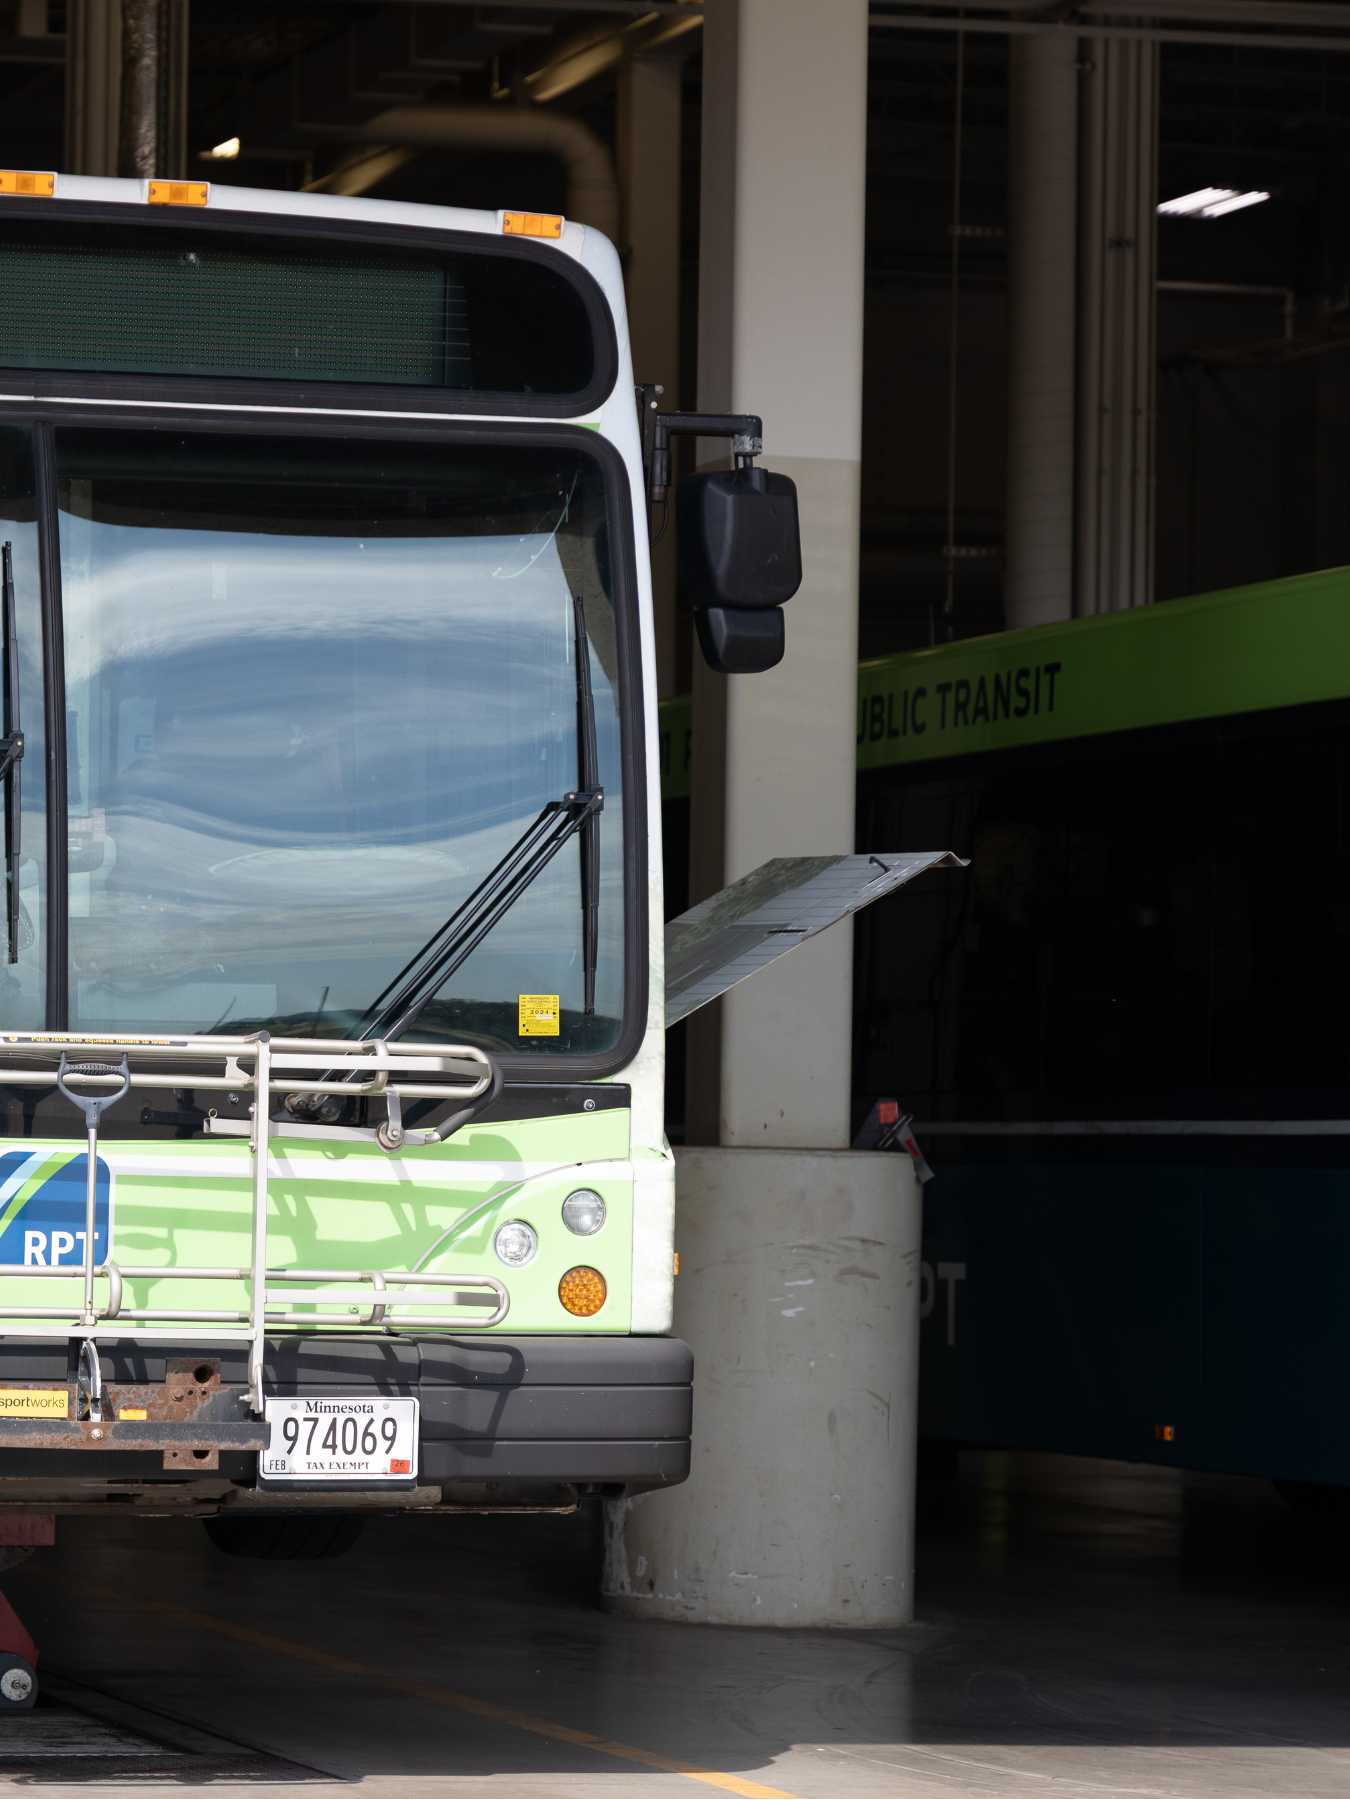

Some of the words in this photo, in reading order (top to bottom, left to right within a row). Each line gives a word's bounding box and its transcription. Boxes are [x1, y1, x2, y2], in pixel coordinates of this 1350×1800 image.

[856, 687, 927, 746] UBLIC
[936, 661, 1062, 731] TRANSIT
[304, 1400, 375, 1414] Minnesota
[282, 1416, 398, 1456] 974069
[269, 1459, 286, 1471] FEB
[306, 1461, 325, 1470] TAX
[329, 1461, 371, 1471] EXEMPT
[394, 1459, 405, 1468] 26
